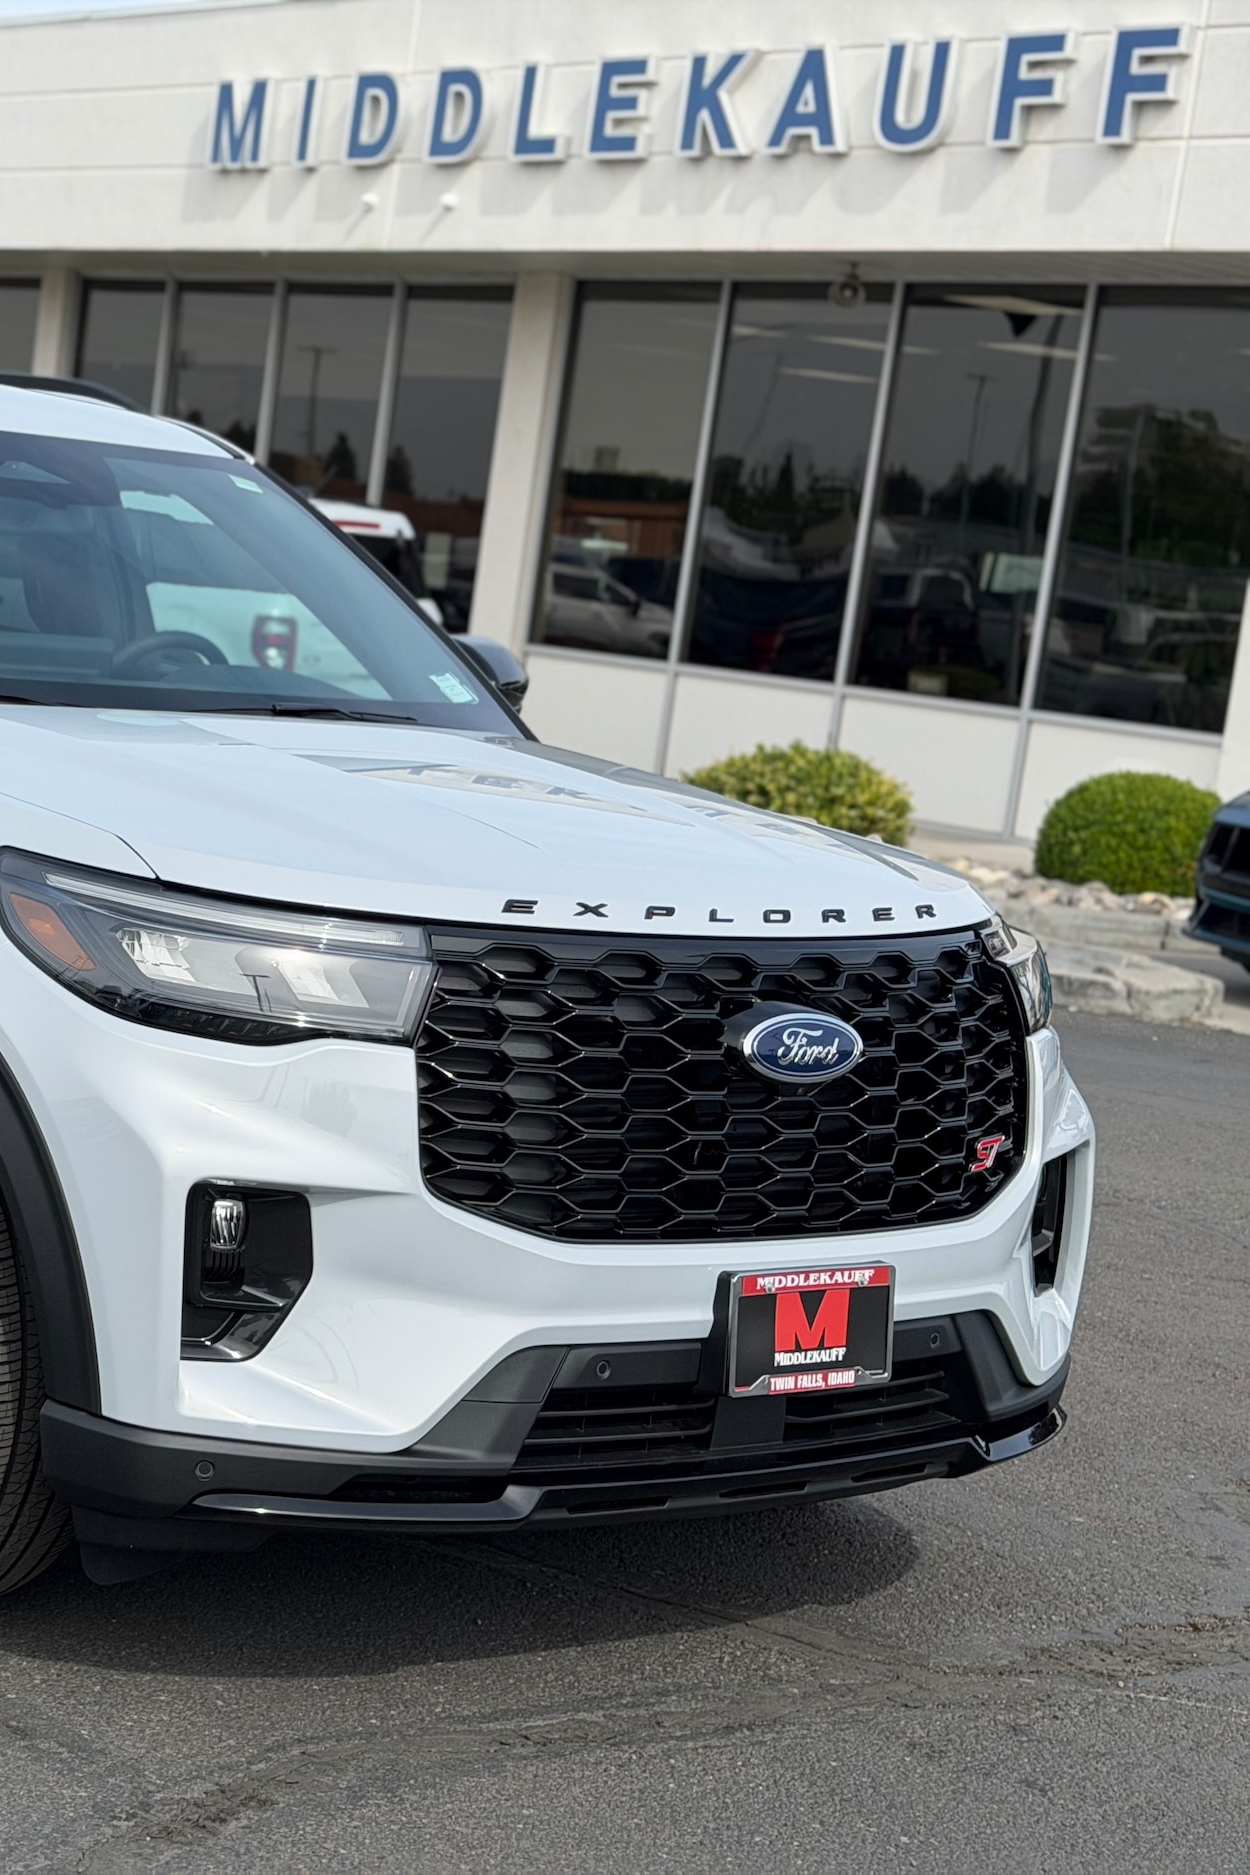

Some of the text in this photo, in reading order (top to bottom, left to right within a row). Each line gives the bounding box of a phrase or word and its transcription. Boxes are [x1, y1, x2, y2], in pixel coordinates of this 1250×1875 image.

[209, 25, 1187, 167] MIDDLEKAUFF
[501, 898, 937, 924] EXPLORER
[777, 1027, 839, 1066] Ford
[970, 1134, 1005, 1172] ST
[775, 1288, 850, 1351] M
[774, 1347, 846, 1367] MIDDLEKAUFF
[770, 1370, 855, 1391] TWIN FALLS, IDAHO
